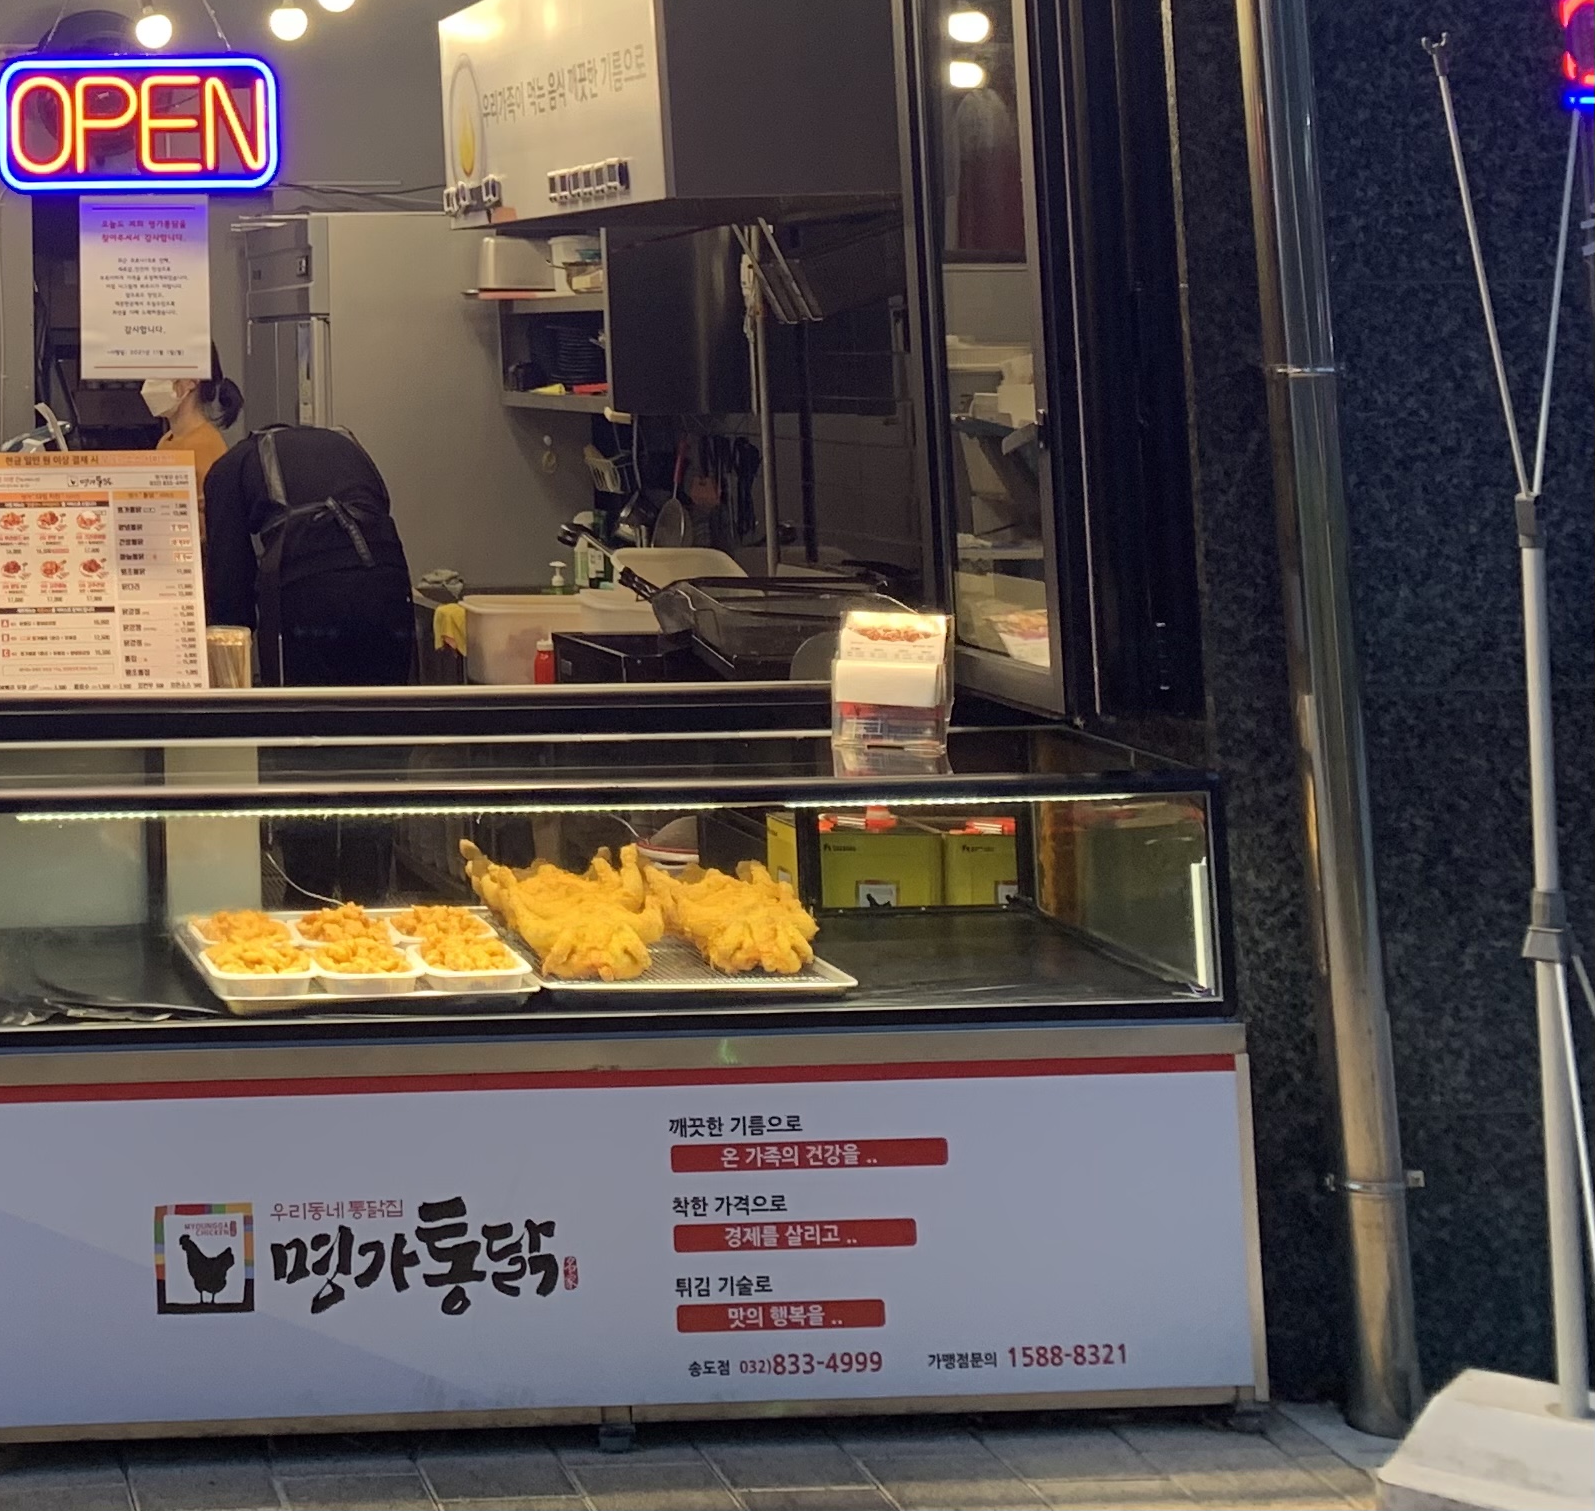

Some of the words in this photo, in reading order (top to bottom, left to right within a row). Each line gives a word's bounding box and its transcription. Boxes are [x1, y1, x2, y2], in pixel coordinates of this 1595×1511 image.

[548, 67, 567, 110] 음식
[600, 44, 647, 93] 기름으로
[10, 75, 266, 175] OPEN
[668, 1116, 724, 1138] 깨끗한
[730, 1115, 804, 1136] 기름으로
[720, 1147, 740, 1168] 온
[745, 1145, 800, 1168] 가족의
[806, 1143, 861, 1166] 건강을
[270, 1200, 345, 1221] 우리동네
[347, 1199, 404, 1220] 통닭집
[672, 1196, 709, 1217] 착한
[714, 1195, 788, 1216] 가격으로
[724, 1226, 779, 1248] 경제를
[785, 1224, 841, 1245] 살리고
[270, 1196, 560, 1316] 명가통닭
[675, 1276, 710, 1298] 튀김
[718, 1275, 773, 1297] 기술로
[727, 1306, 764, 1329] 맛의
[769, 1304, 826, 1327] 행복을
[688, 1360, 731, 1377] 송도점
[927, 1351, 998, 1370] 가맹점문의
[1008, 1343, 1128, 1368] 1588-8321
